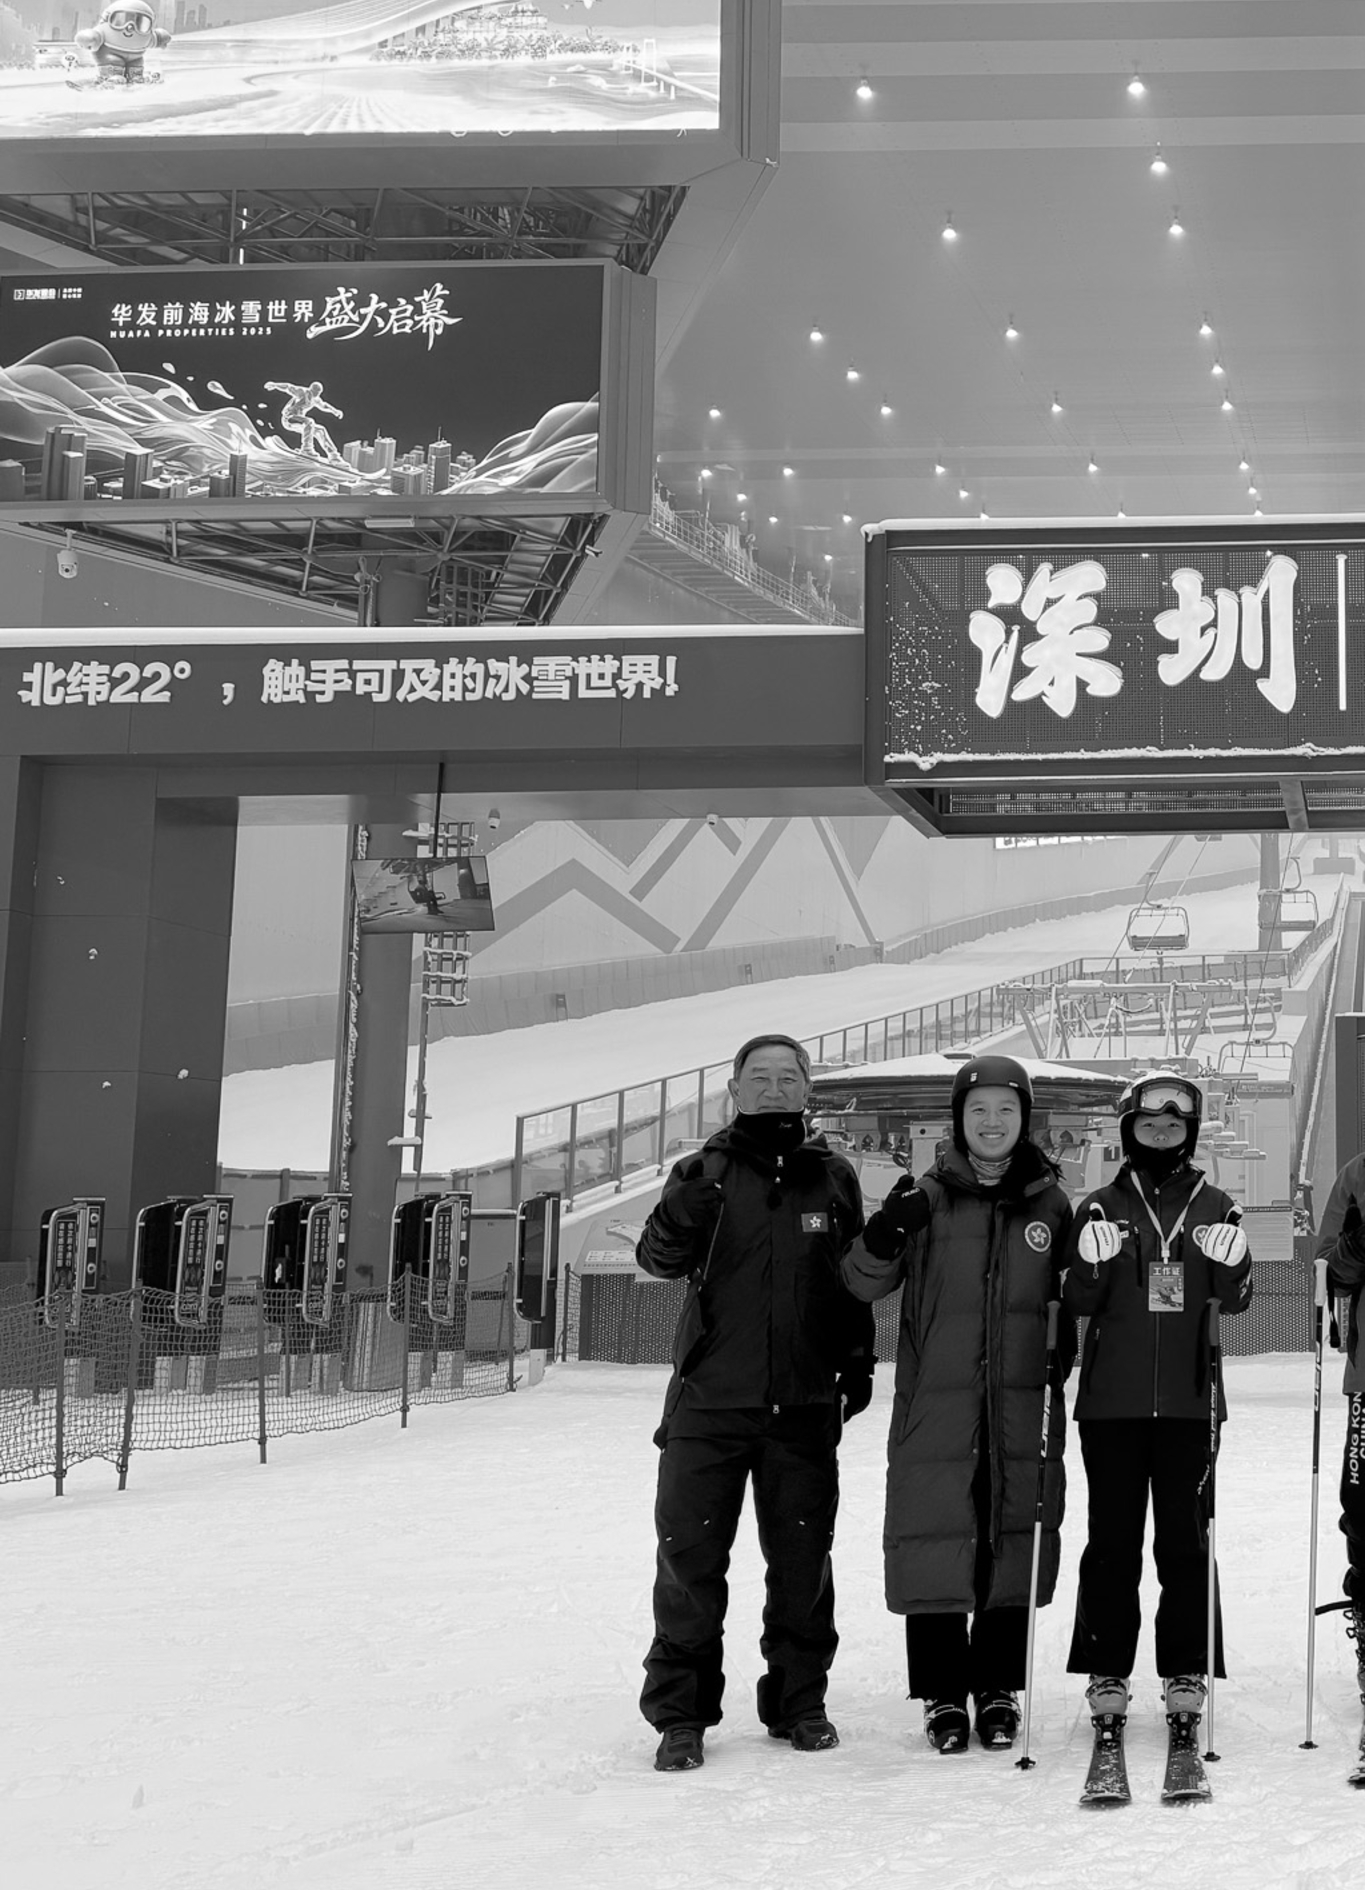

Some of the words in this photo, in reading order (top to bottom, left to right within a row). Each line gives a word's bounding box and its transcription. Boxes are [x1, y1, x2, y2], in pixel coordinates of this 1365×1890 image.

[110, 299, 314, 327] 华发前海冰雪世界
[306, 282, 463, 351] 盛大启幕
[110, 329, 151, 339] HUAFA
[157, 327, 235, 338] PROPERTIES
[242, 326, 272, 337] 2025
[968, 555, 1299, 719] 深圳
[1351, 1391, 1363, 1429] KON
[1349, 1432, 1360, 1485] HONG
